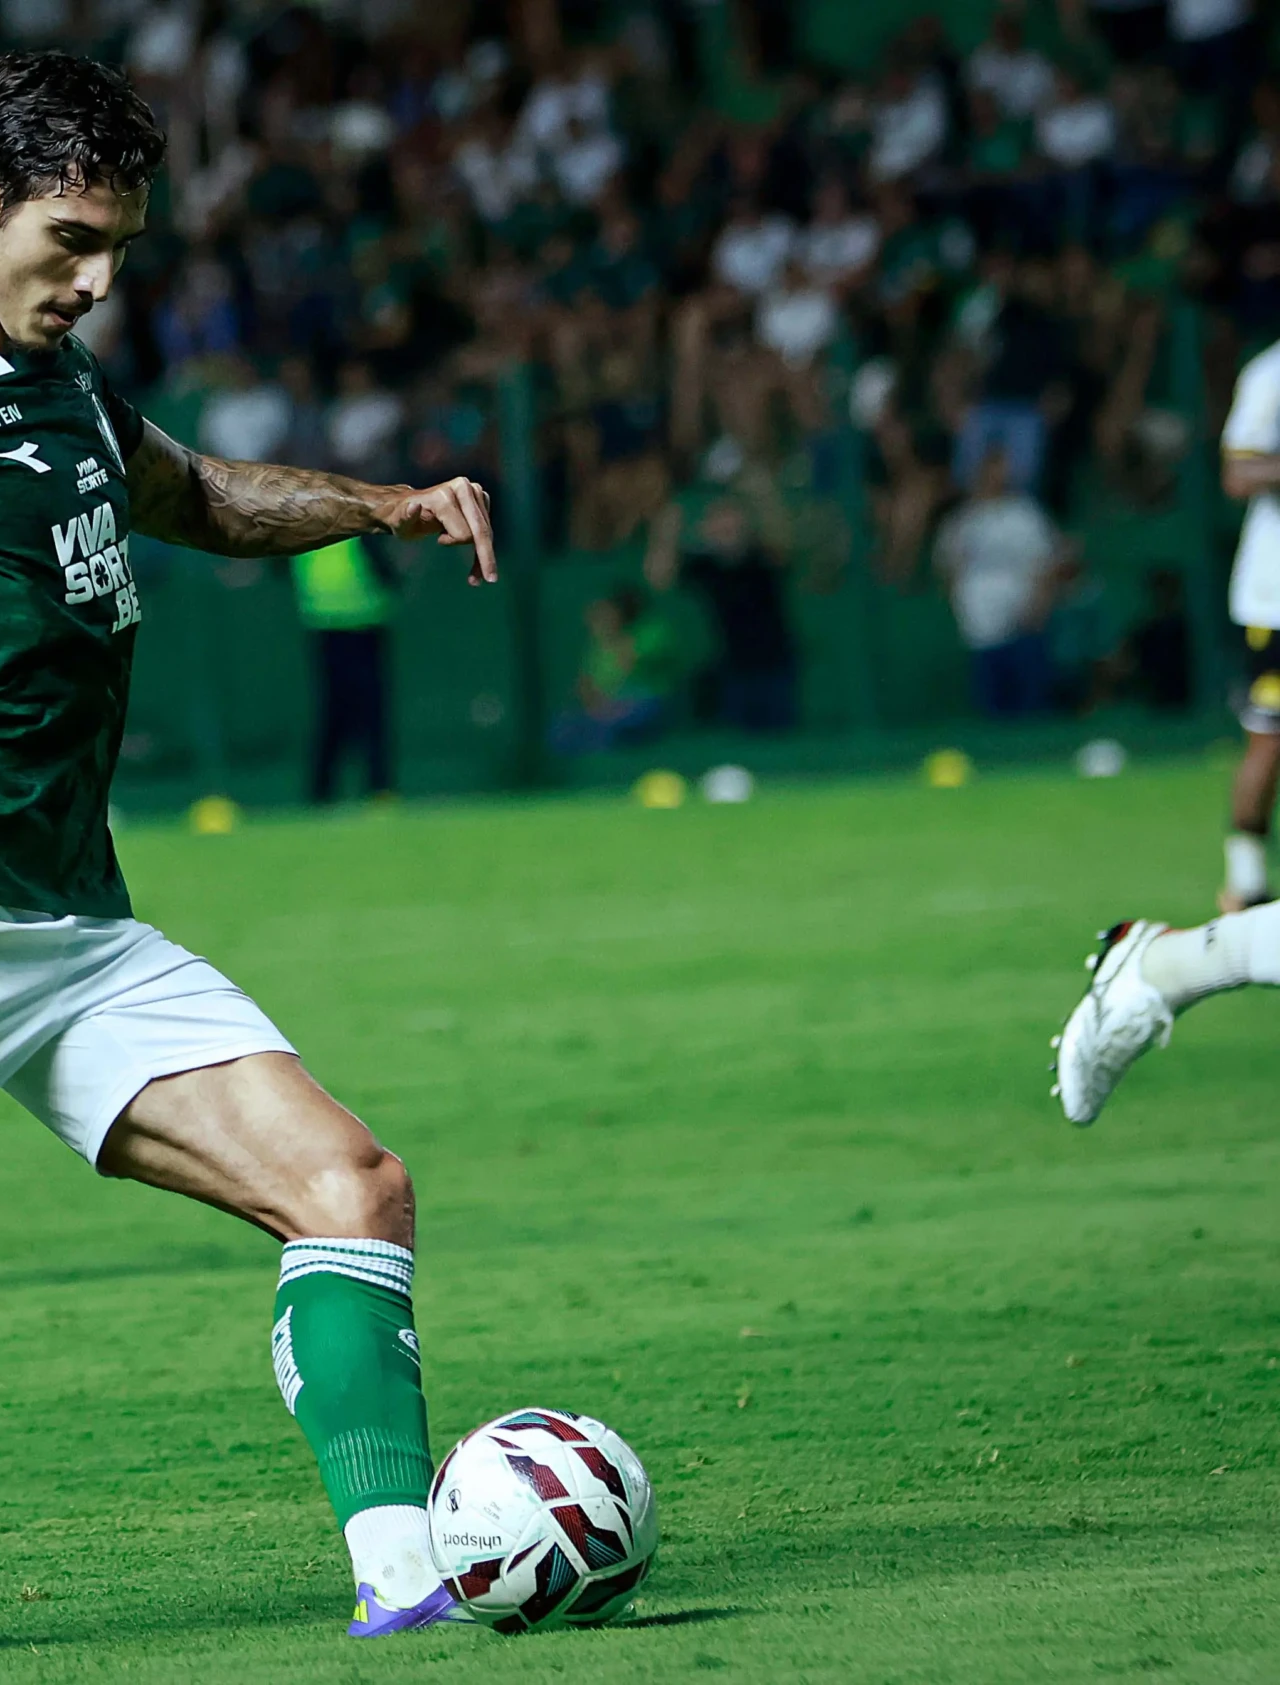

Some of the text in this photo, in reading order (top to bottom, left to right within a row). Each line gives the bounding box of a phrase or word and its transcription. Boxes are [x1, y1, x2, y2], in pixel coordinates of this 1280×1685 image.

[76, 457, 99, 477] VIVA
[77, 468, 108, 495] SORTE
[51, 502, 116, 567] VIVA
[443, 1532, 502, 1550] uhlsport
